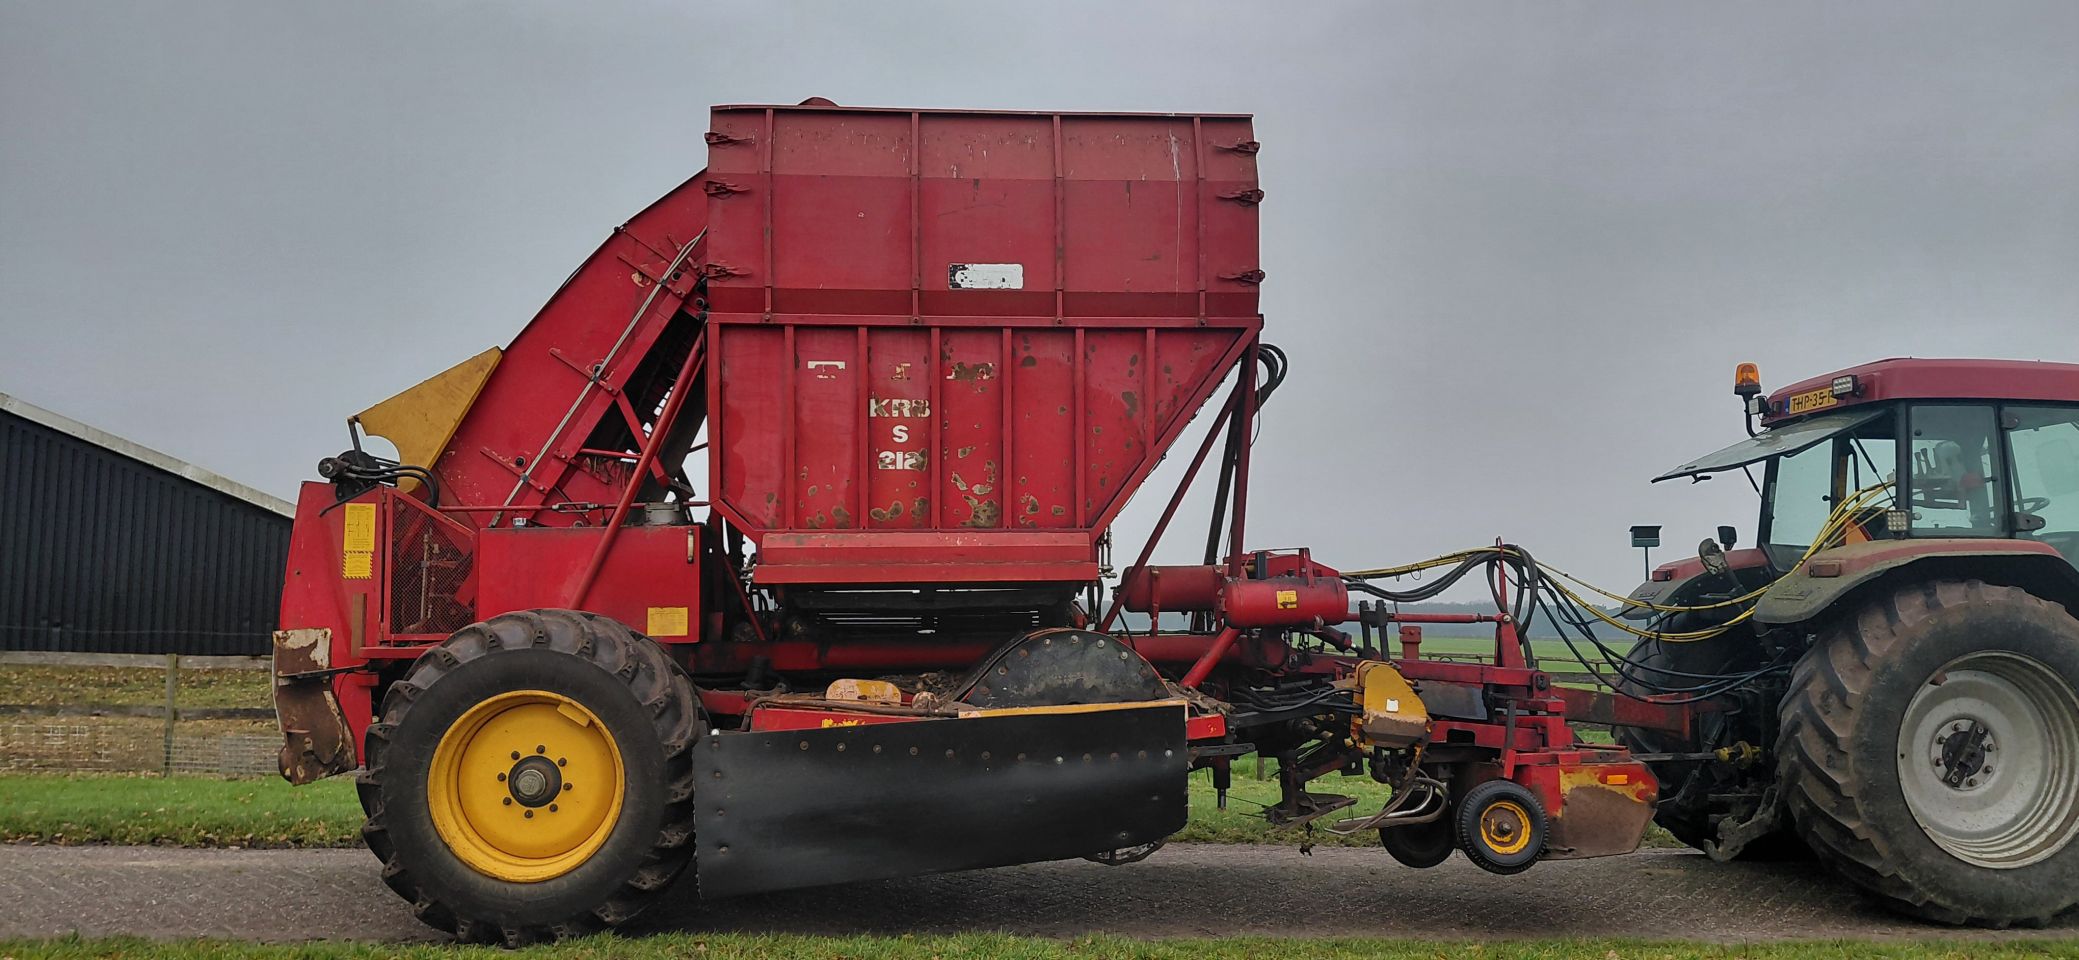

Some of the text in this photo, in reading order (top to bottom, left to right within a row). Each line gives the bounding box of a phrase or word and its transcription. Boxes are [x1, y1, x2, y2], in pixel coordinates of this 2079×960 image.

[869, 399, 931, 417] KRB
[892, 425, 909, 443] S
[878, 451, 925, 470] 212
